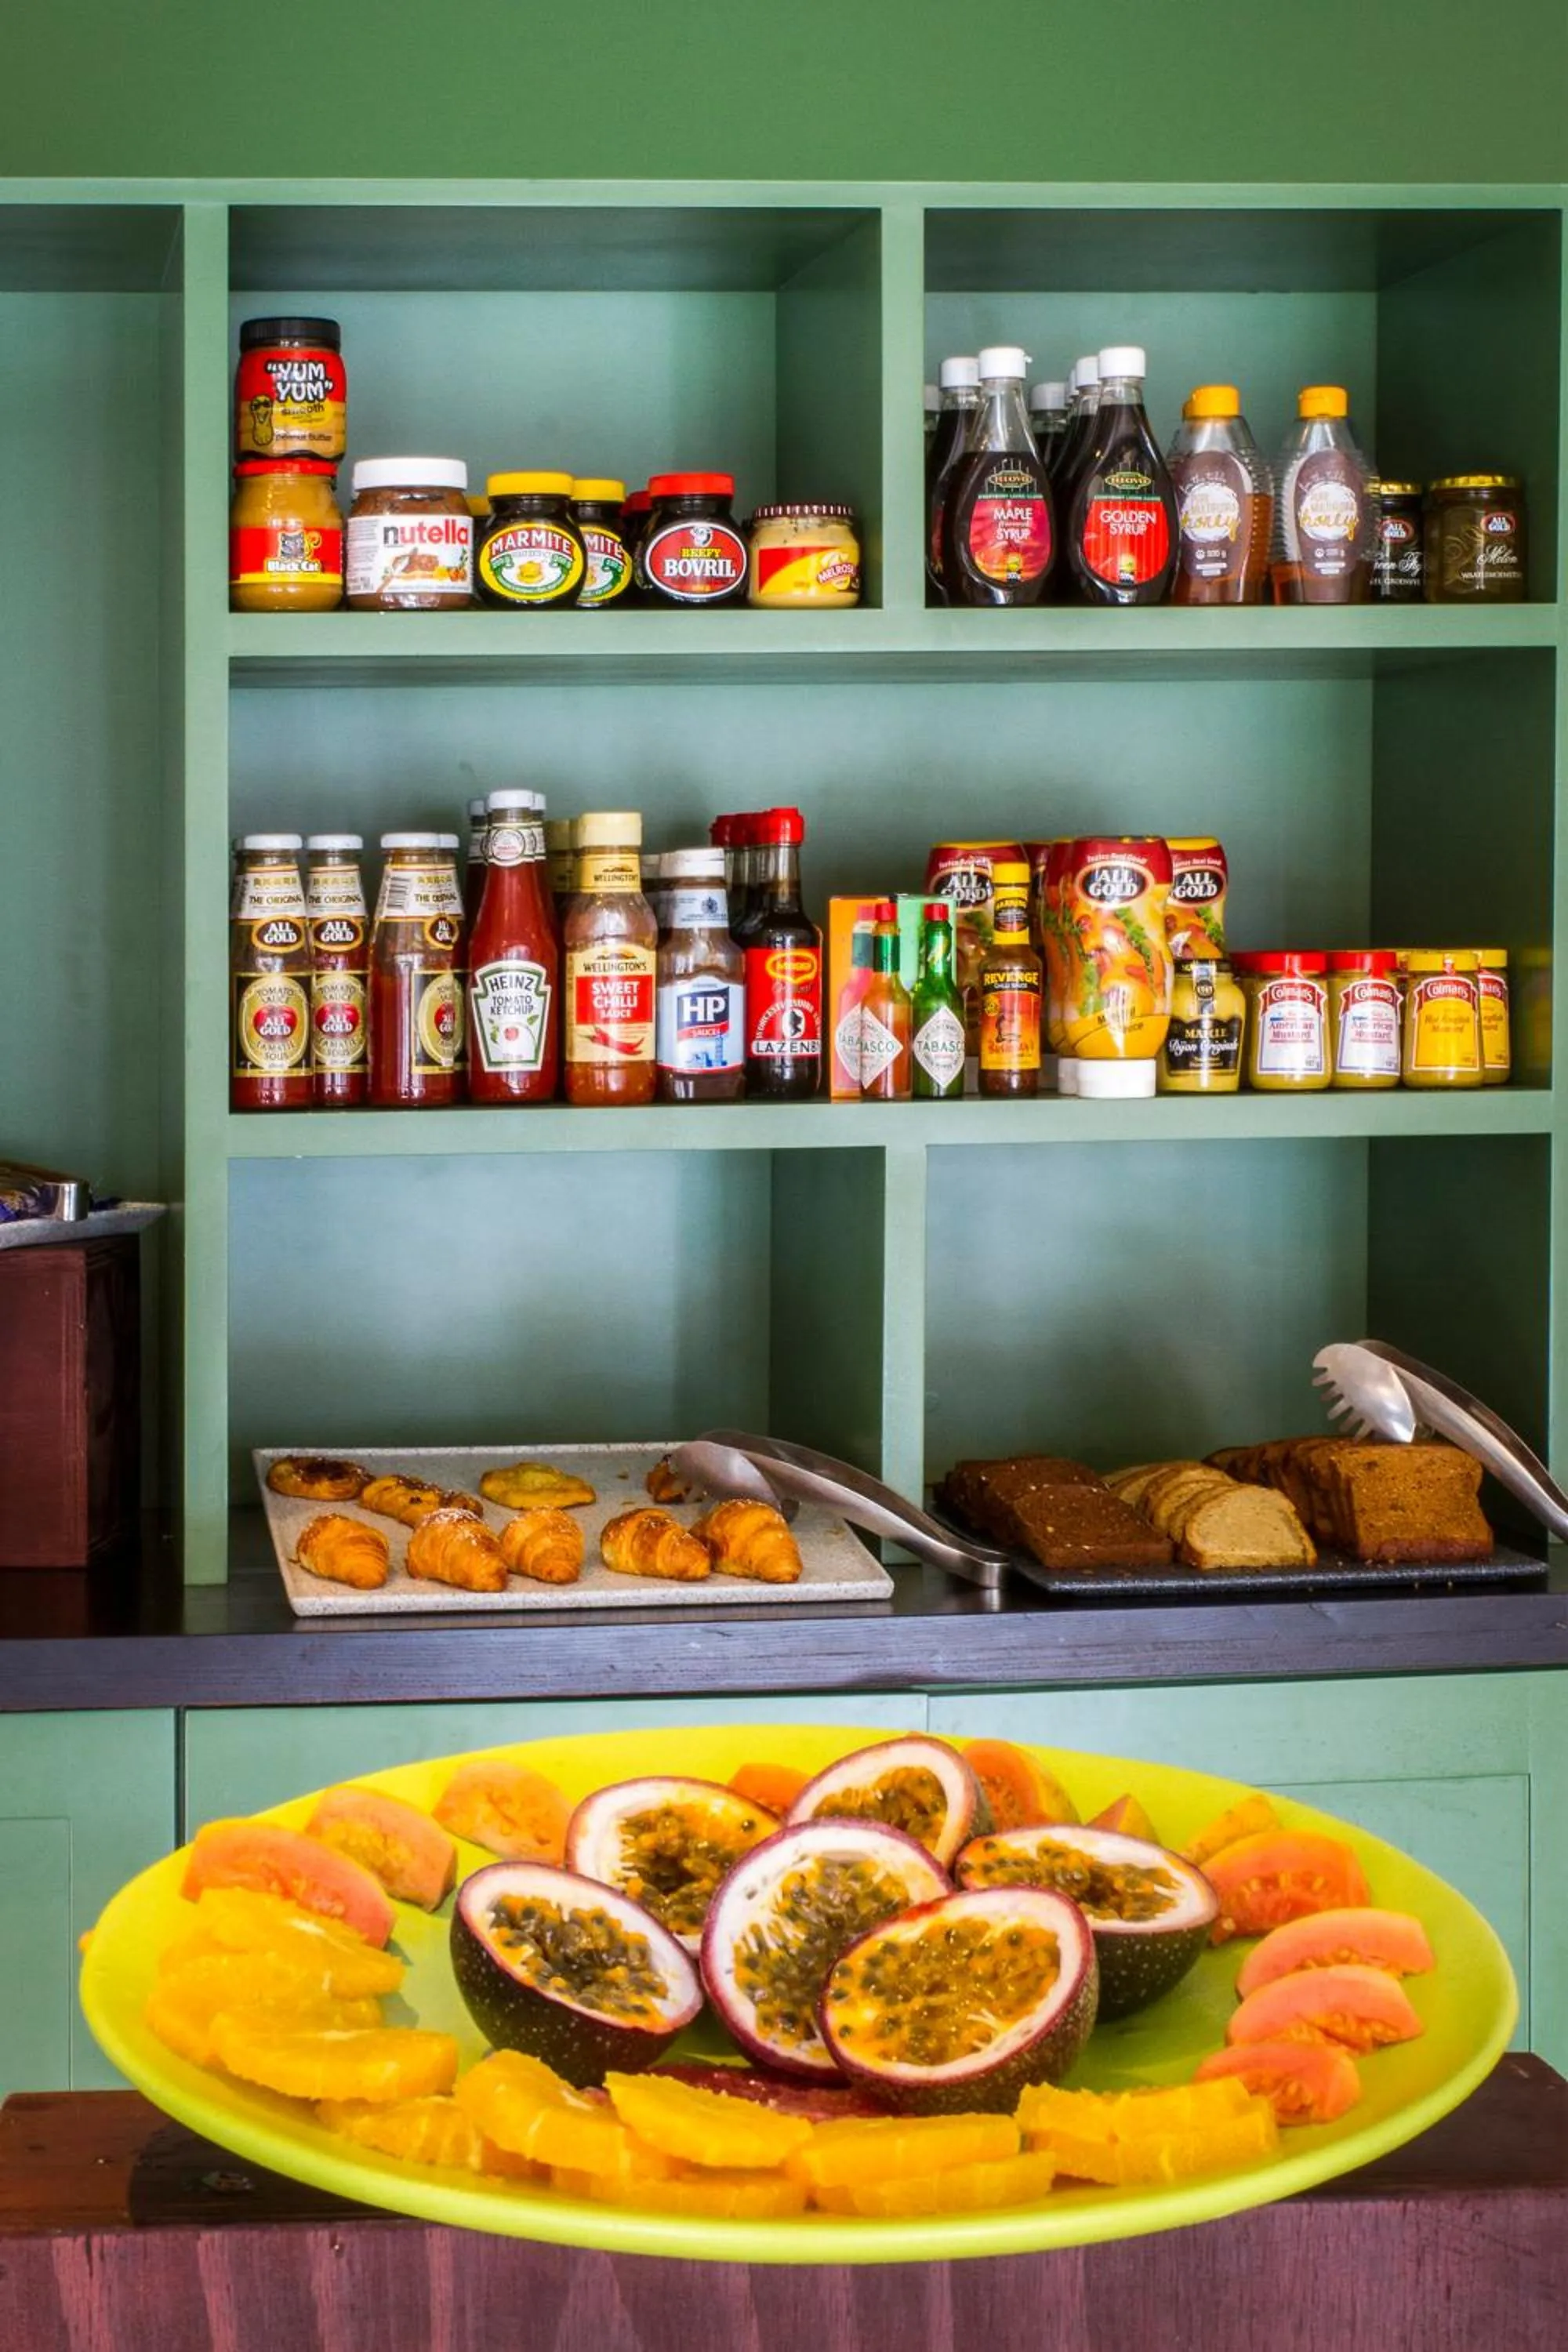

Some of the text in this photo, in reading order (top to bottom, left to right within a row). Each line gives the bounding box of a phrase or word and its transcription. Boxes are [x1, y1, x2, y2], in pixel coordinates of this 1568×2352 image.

[993, 508, 1033, 520] MAPLE
[1100, 510, 1158, 524] GOLDEN
[383, 518, 468, 545] nutella
[996, 528, 1031, 540] SYRUP
[1109, 523, 1148, 536] SYRUP
[491, 529, 572, 556] MARMITE
[681, 548, 722, 557] BEEFY
[663, 558, 737, 577] BOVRIL
[946, 873, 982, 888] ALL
[1096, 868, 1134, 883] ALL
[1181, 872, 1214, 885] ALL
[1088, 882, 1138, 896] GOLD
[1173, 884, 1218, 898] GOLD
[269, 921, 294, 932] ALL
[325, 921, 350, 932] ALL
[263, 931, 297, 944] GOLD
[321, 931, 354, 942] GOLD
[488, 975, 535, 993] HEINZ
[983, 971, 1040, 986] REVENGE
[592, 980, 641, 995] SWEET
[1426, 982, 1468, 998] Colman's
[491, 994, 532, 1006] TOMATO
[490, 1004, 535, 1016] KETCHUP
[683, 996, 726, 1022] HP
[263, 1016, 286, 1027] ALL
[328, 1014, 348, 1025] ALL
[260, 1025, 292, 1036] GOLD
[322, 1022, 354, 1033] GOLD
